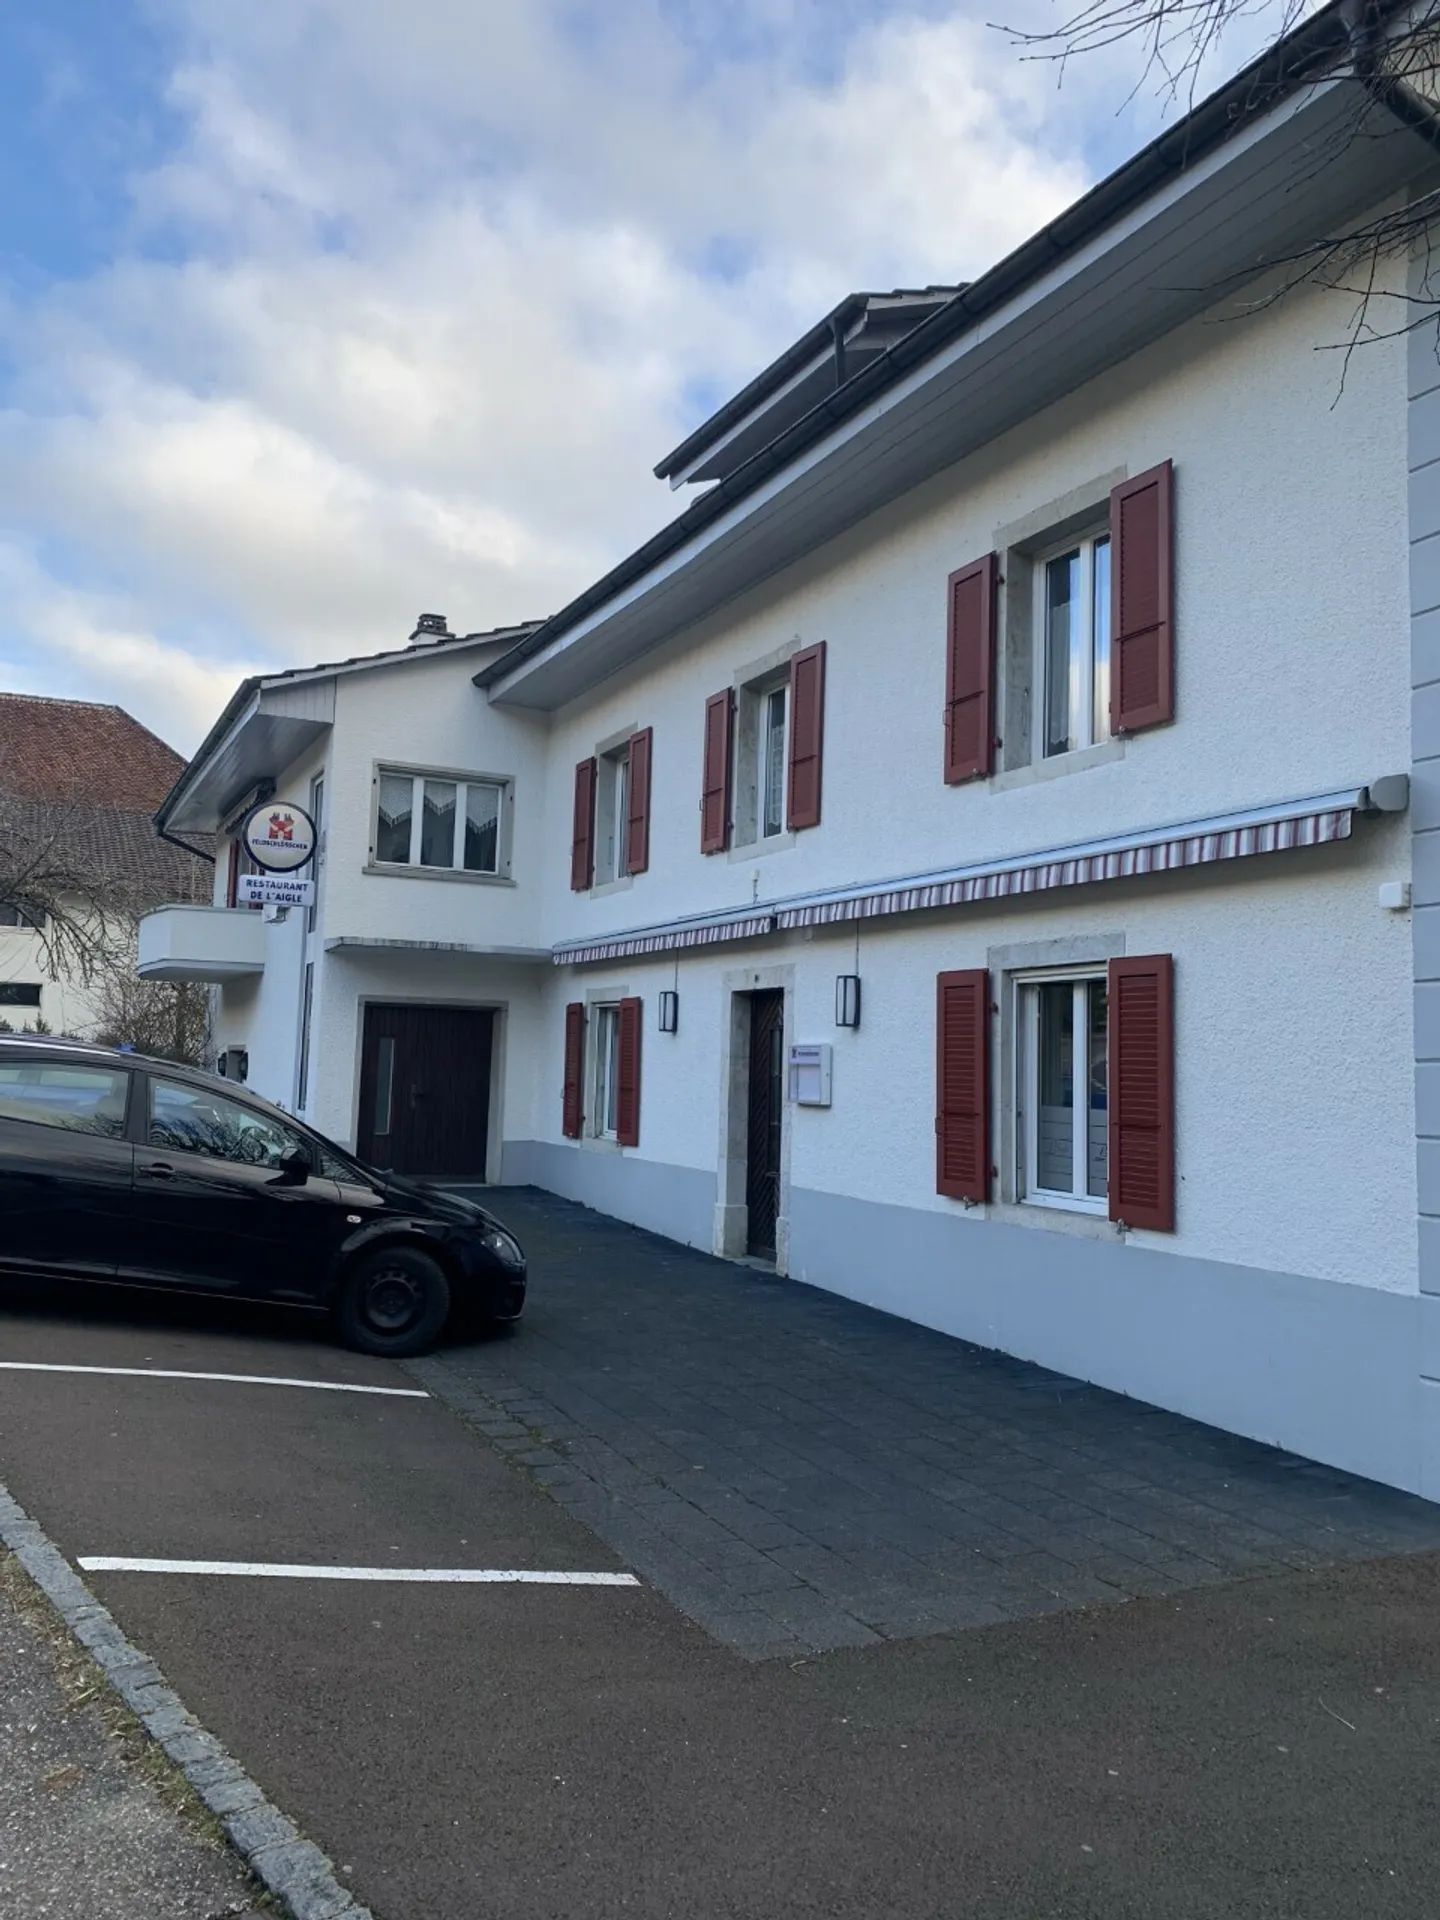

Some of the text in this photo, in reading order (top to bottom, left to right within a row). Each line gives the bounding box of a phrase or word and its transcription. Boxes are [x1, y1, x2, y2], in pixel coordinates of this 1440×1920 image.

[246, 879, 308, 891] RESTAURANT
[250, 891, 302, 903] DE L'AIGLE
